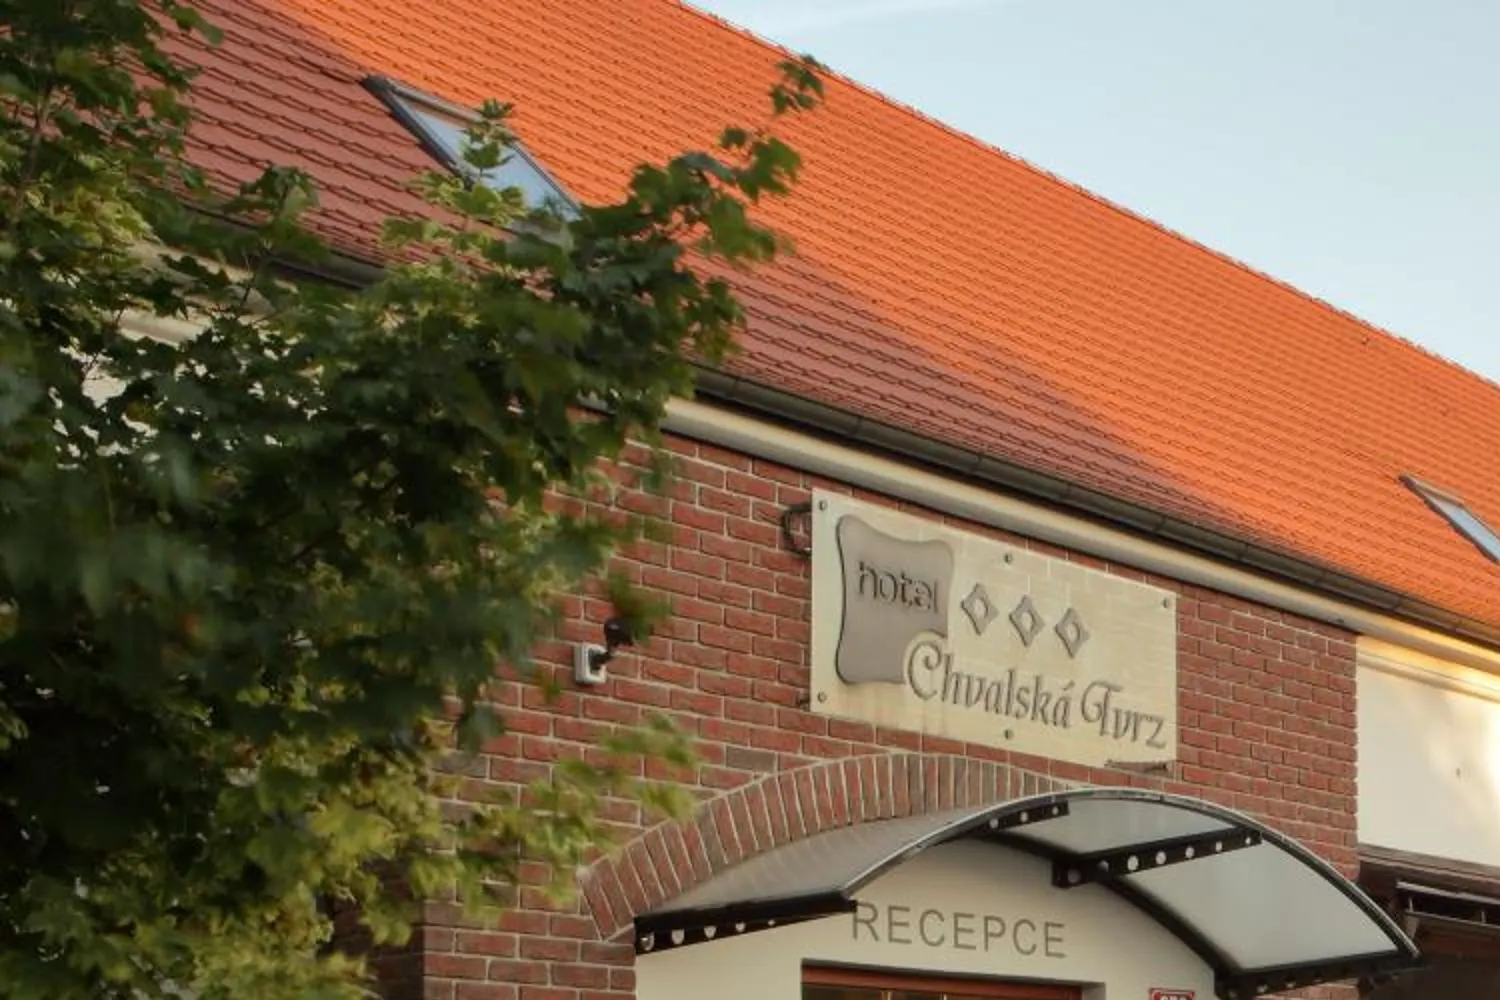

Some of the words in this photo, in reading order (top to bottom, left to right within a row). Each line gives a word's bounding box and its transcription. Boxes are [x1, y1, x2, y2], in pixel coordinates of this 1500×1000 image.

[907, 641, 1075, 729] Chvalská
[1081, 680, 1167, 750] Tvrz
[852, 901, 1067, 959] RECEPCE
